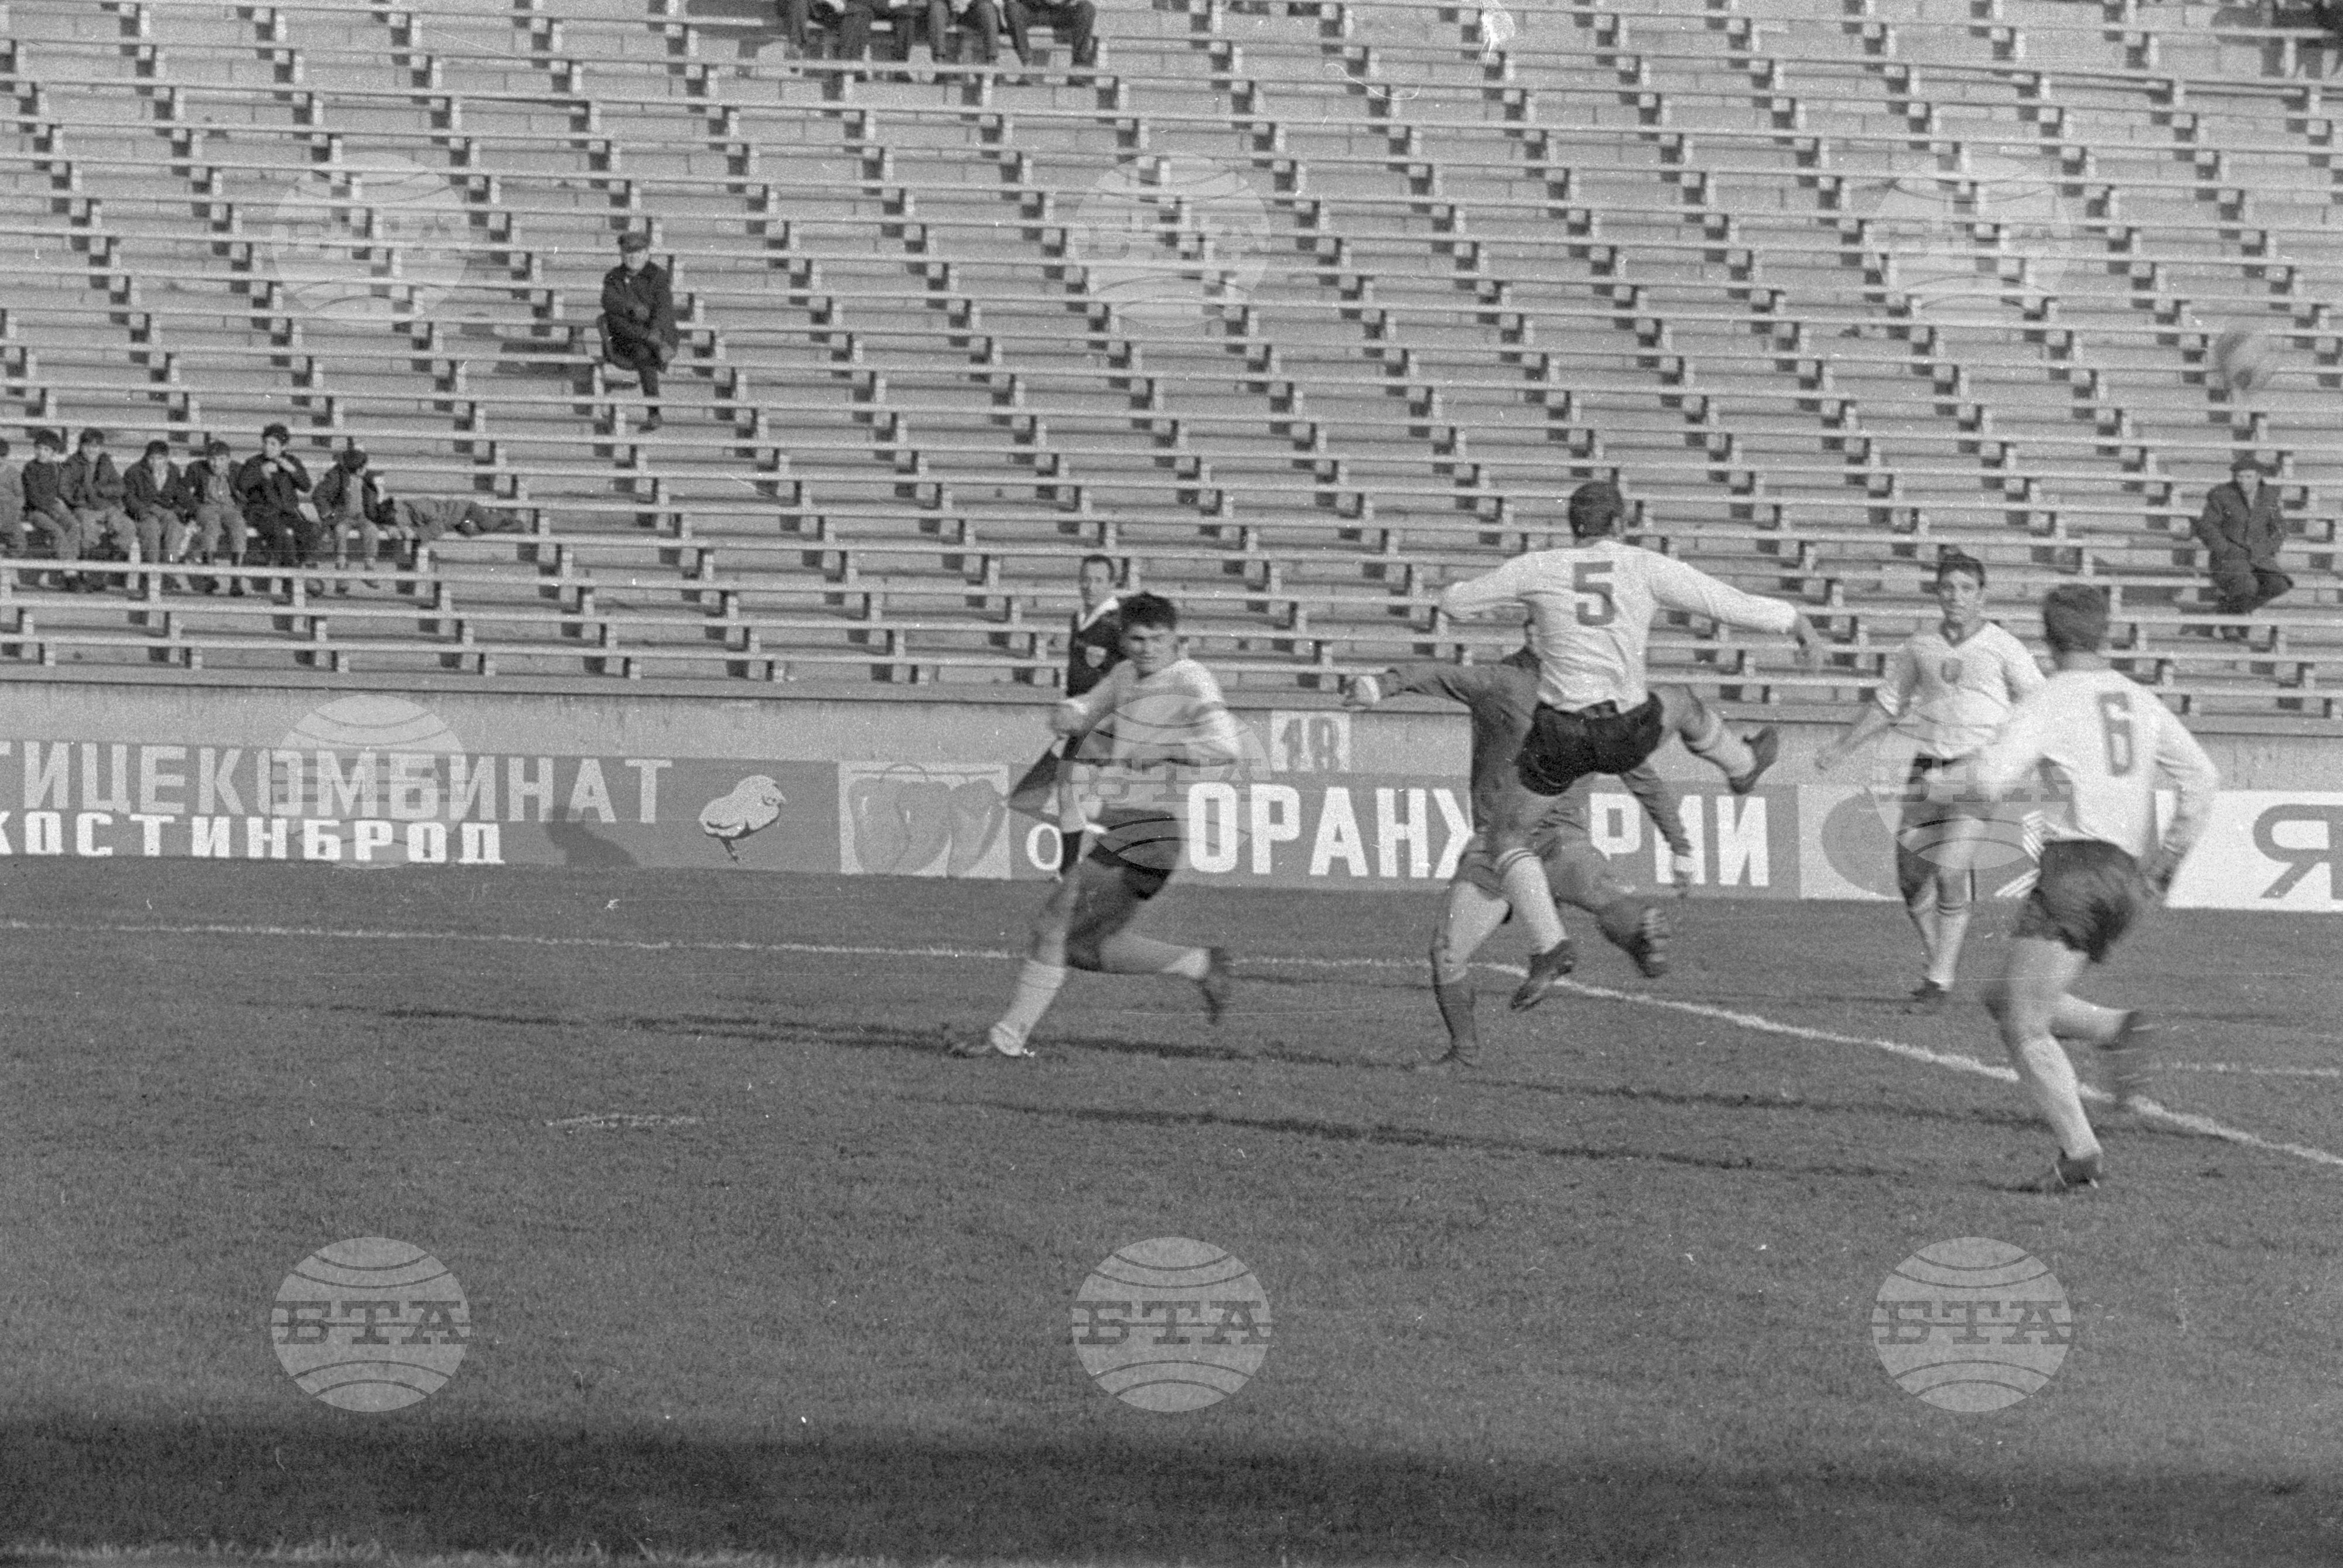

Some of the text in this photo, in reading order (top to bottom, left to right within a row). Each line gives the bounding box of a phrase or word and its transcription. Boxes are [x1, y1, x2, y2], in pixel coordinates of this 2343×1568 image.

[1573, 561, 1615, 626] 5
[2097, 691, 2133, 777] 6
[1188, 782, 1769, 886] ОРАНРИИ
